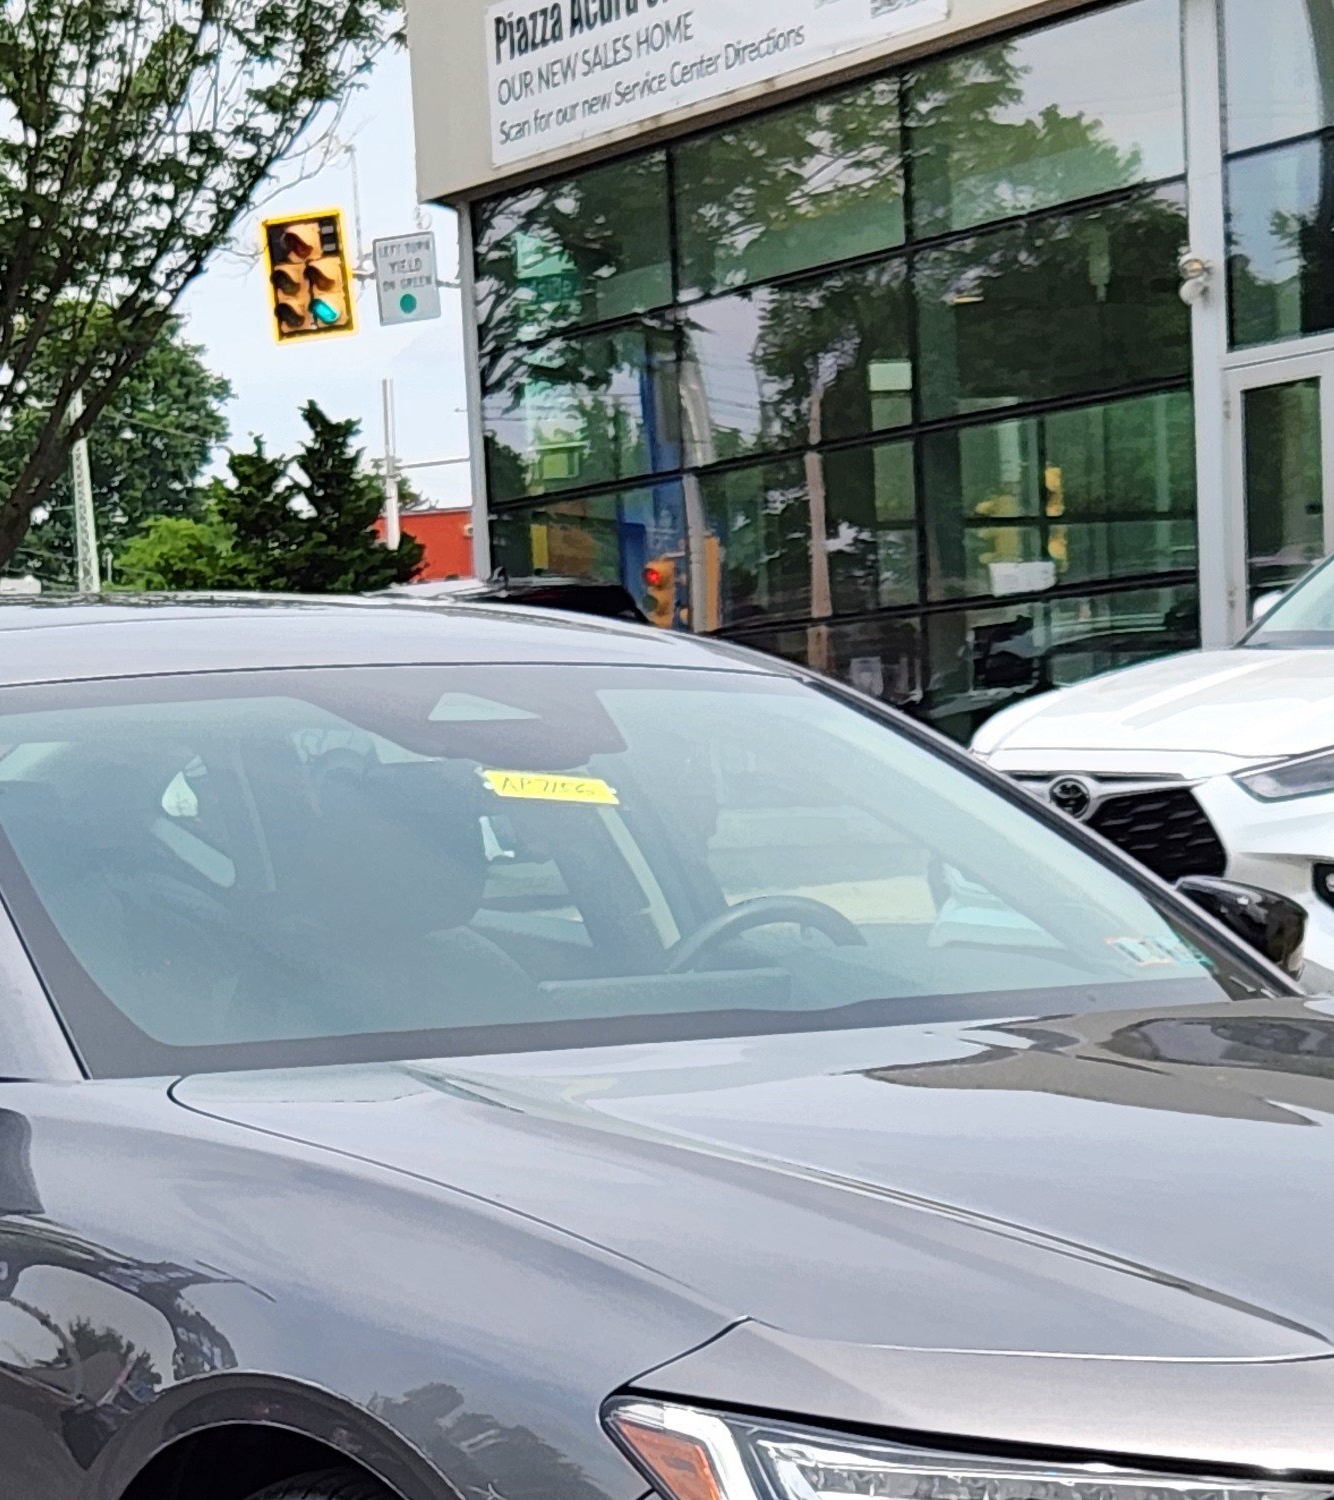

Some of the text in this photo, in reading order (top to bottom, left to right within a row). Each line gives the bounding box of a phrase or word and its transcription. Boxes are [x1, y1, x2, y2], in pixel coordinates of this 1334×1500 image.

[493, 2, 564, 65] Piazza
[497, 9, 695, 106] OUR NEW SALES HOME
[498, 24, 805, 146] Scan for our new Service Center Directions
